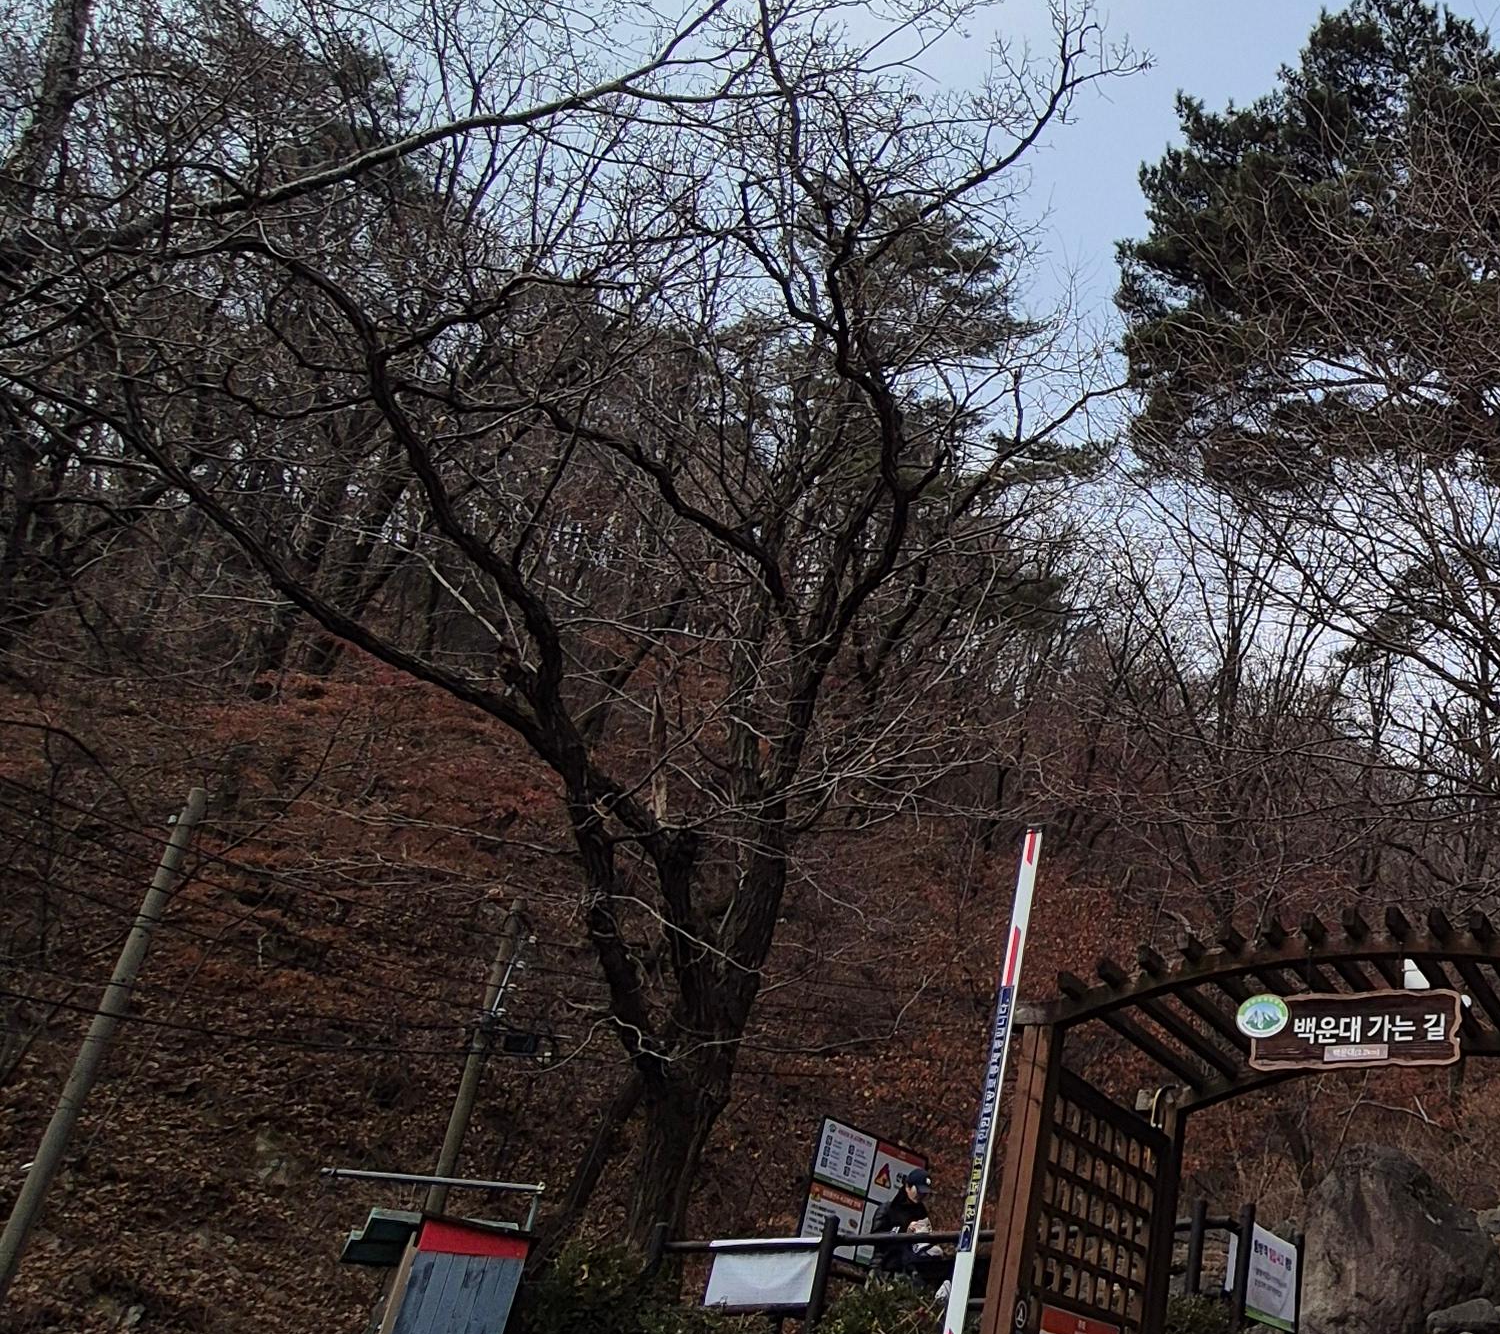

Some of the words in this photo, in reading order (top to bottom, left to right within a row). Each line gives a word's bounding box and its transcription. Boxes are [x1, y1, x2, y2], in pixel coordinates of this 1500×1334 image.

[1293, 1016, 1362, 1045] 백운대
[1367, 1015, 1416, 1042] 가는
[1423, 1013, 1446, 1042] 길
